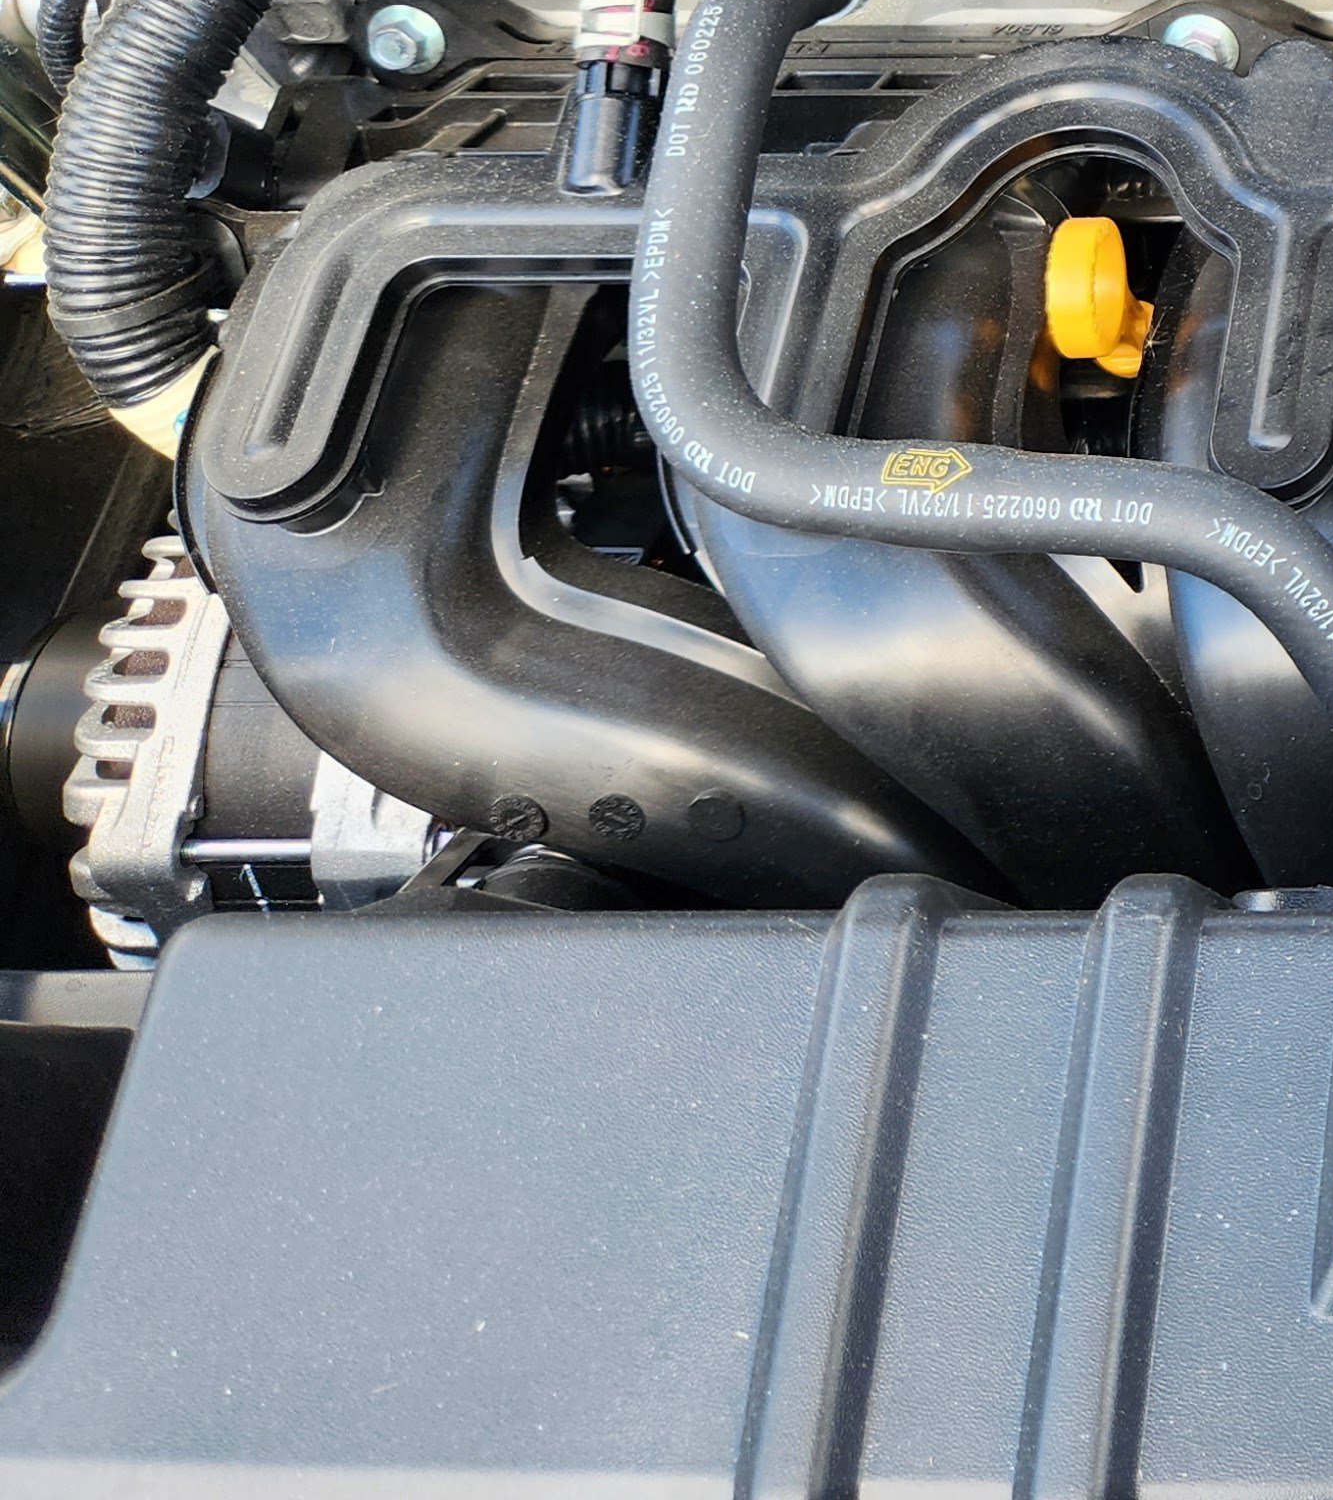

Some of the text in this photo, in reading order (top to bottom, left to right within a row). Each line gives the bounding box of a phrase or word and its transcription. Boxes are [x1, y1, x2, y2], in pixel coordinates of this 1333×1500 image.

[665, 123, 692, 156] DOT
[684, 5, 724, 76] 060225
[642, 206, 674, 282] >EPDM<
[641, 372, 684, 445] 060225
[715, 461, 757, 494] DOT
[888, 452, 950, 480] ENG
[809, 483, 888, 513] >EPDM<
[982, 493, 1061, 523] 060225
[1111, 500, 1153, 526] DOT
[1203, 516, 1288, 576] >EPDM<
